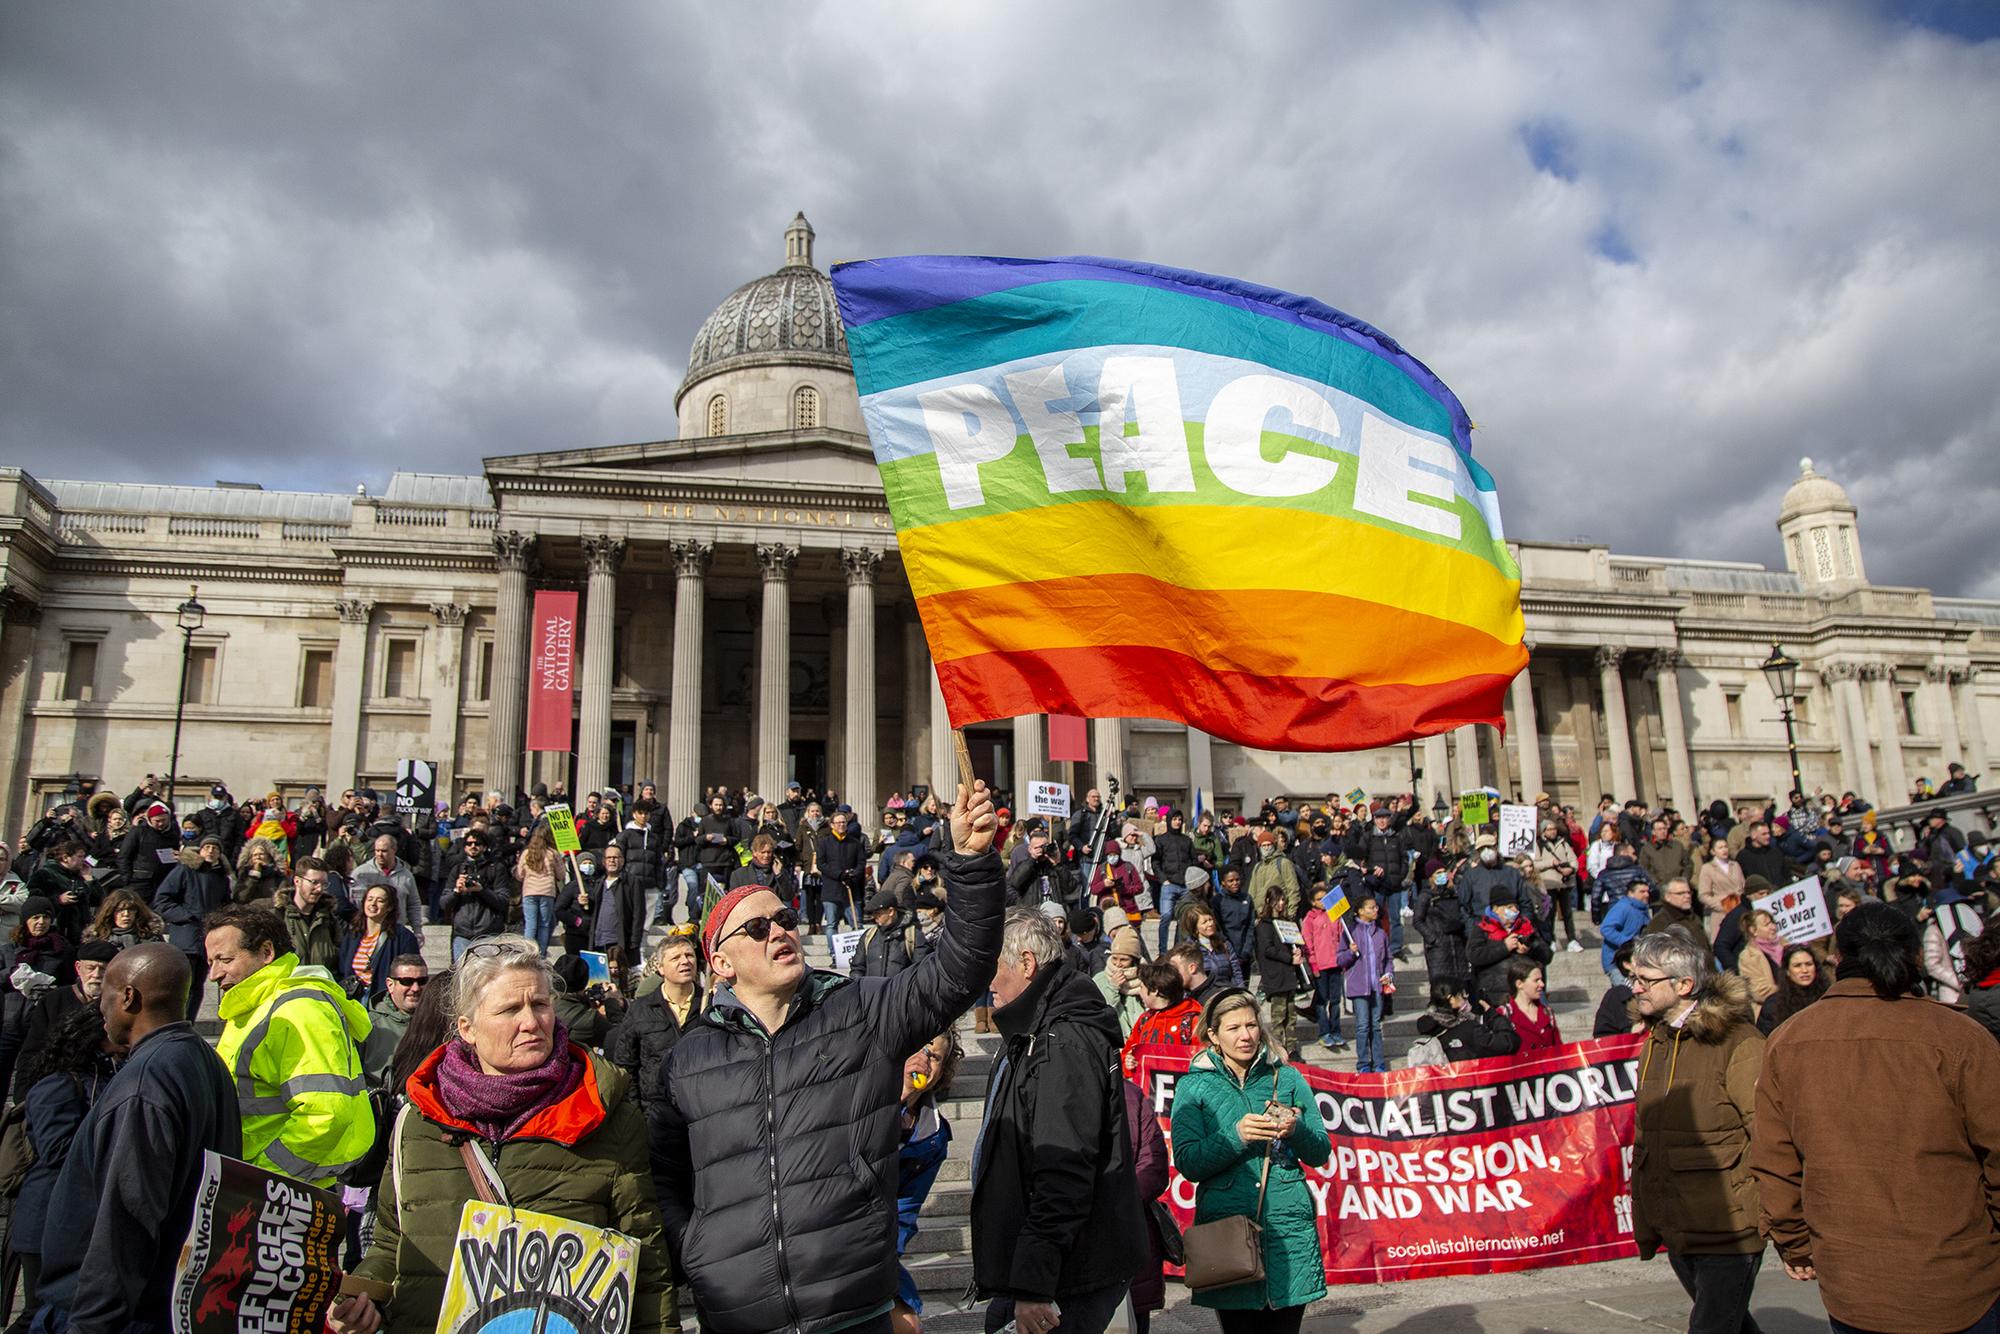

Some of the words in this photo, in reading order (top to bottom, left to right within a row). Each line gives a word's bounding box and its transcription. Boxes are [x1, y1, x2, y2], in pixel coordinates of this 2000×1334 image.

[917, 356, 1462, 540] PEACE
[642, 502, 696, 519] THE
[714, 506, 854, 527] NATIONAL
[543, 616, 558, 690] NATIONAL
[556, 617, 572, 691] GALLERY
[397, 797, 415, 807] NO
[549, 811, 561, 821] NO
[562, 810, 571, 819] TO
[1035, 795, 1048, 804] the
[1050, 798, 1066, 806] war
[1462, 794, 1475, 802] NO
[1475, 793, 1486, 801] TO
[552, 821, 570, 830] WAR
[1790, 905, 1817, 925] war
[1313, 1086, 1498, 1138] OCIALIST
[1338, 1185, 1423, 1221] AND
[1427, 1178, 1534, 1216] WAR
[237, 1179, 291, 1334] EFUGEES
[306, 1199, 325, 1267] borders
[1387, 1228, 1565, 1259] socialistalternative.net
[263, 1187, 313, 1334] ELCOME
[304, 1213, 337, 1323] deportations
[460, 1227, 630, 1334] WORLD
[176, 1248, 208, 1334] ocialist
[297, 1271, 318, 1300] the
